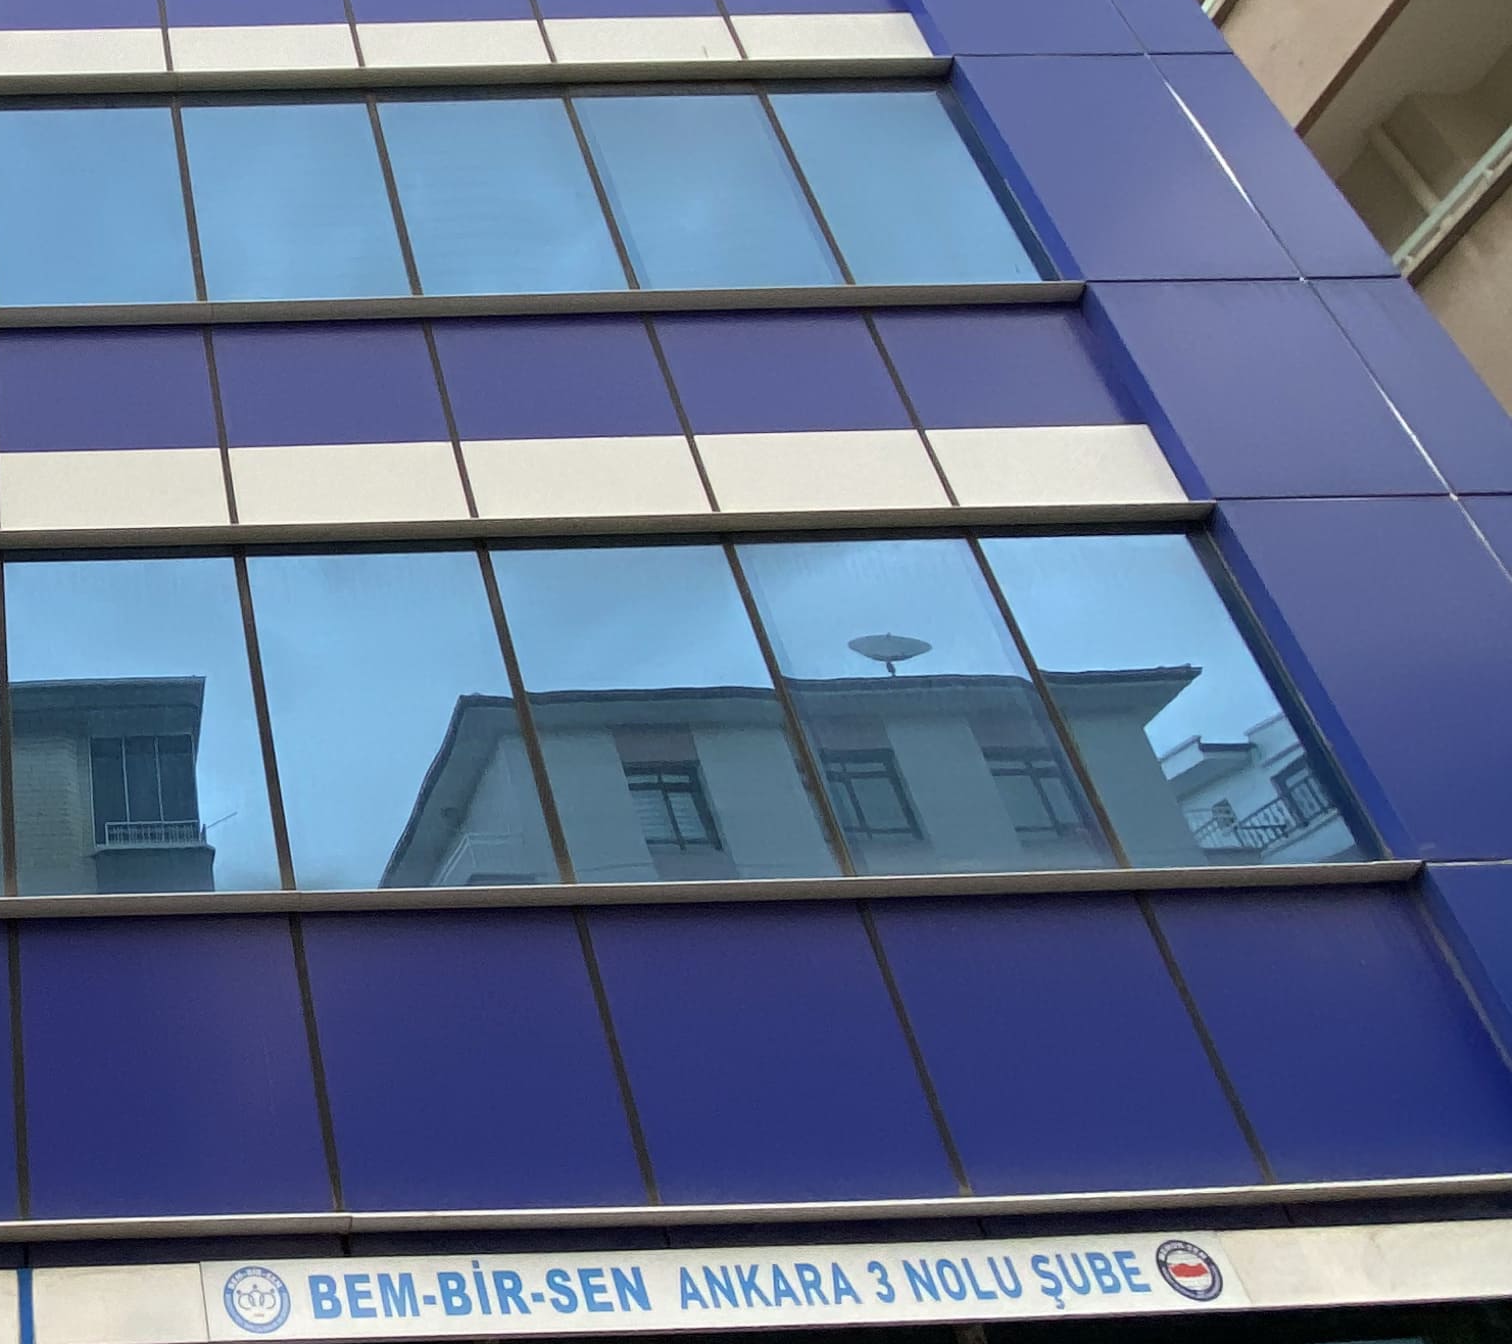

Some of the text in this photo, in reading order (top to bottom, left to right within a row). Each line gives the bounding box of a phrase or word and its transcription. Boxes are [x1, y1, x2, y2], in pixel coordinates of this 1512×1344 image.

[308, 1259, 652, 1320] BEM-BİR-SEN
[679, 1263, 861, 1310] ANKARA
[867, 1259, 897, 1304] 3
[903, 1258, 1024, 1302] NOLU
[1031, 1250, 1151, 1310] ŞUBE
